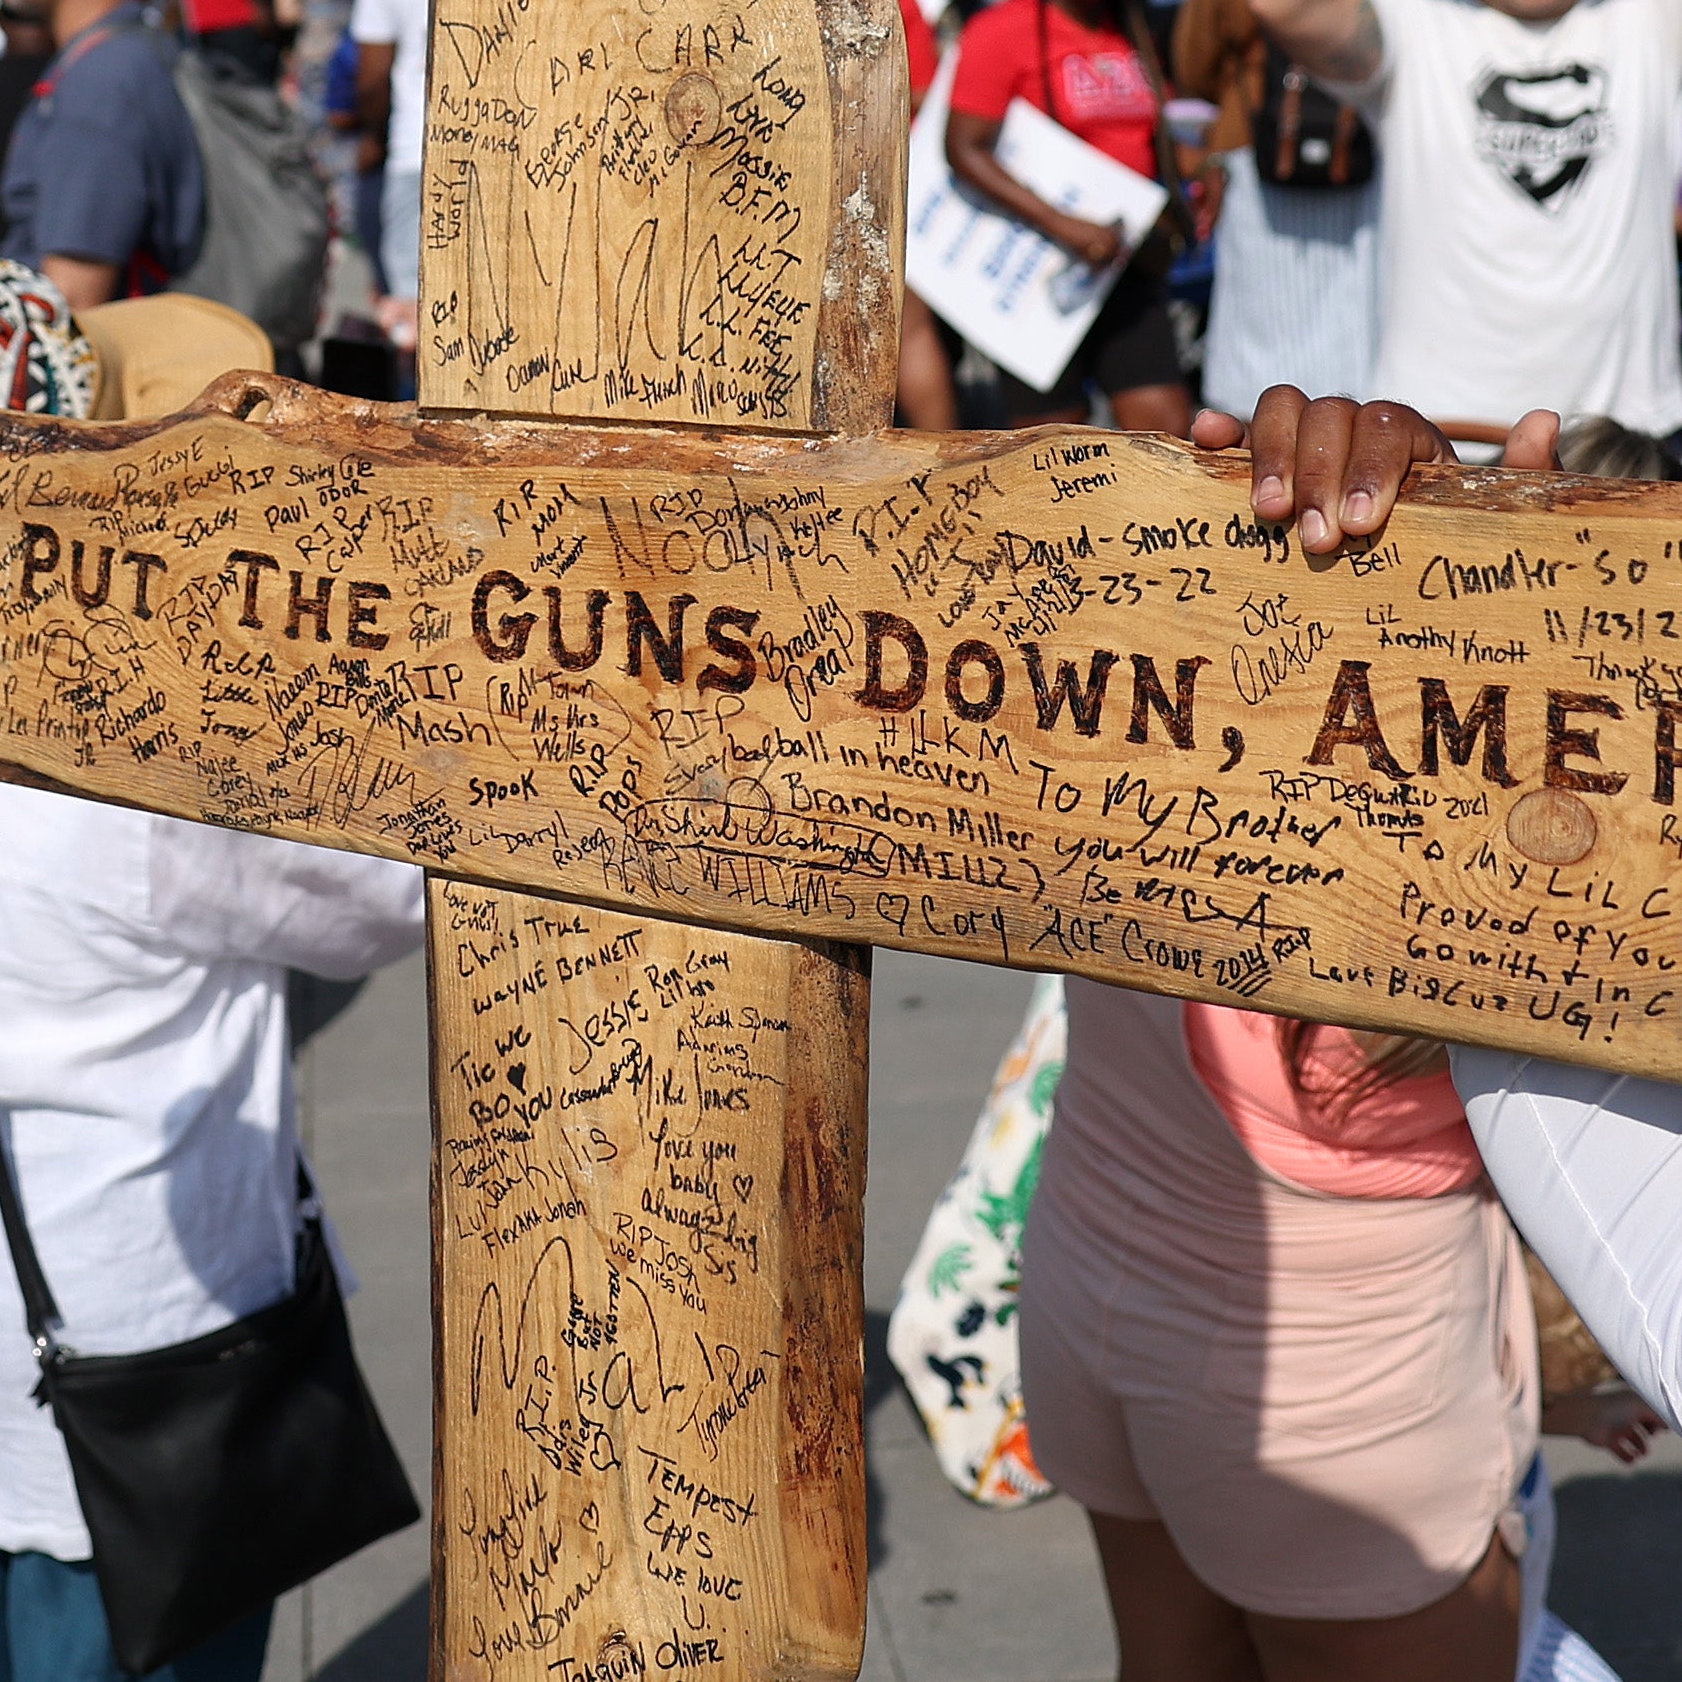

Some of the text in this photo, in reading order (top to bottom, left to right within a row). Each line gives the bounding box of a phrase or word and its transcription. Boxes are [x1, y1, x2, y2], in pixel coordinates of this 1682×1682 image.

[229, 466, 275, 495] RIP
[1334, 542, 1402, 577] Bell
[21, 520, 168, 621] PUT
[226, 547, 392, 651] THE
[471, 568, 762, 696] GUNS
[856, 608, 1246, 774] DOWN,
[386, 660, 463, 701] RIP
[396, 711, 492, 750] Mash
[876, 742, 990, 796] heaven
[781, 772, 1035, 852] Brandon Miller
[1029, 760, 1081, 813] To
[1101, 770, 1179, 854] My
[1382, 831, 1446, 861] To
